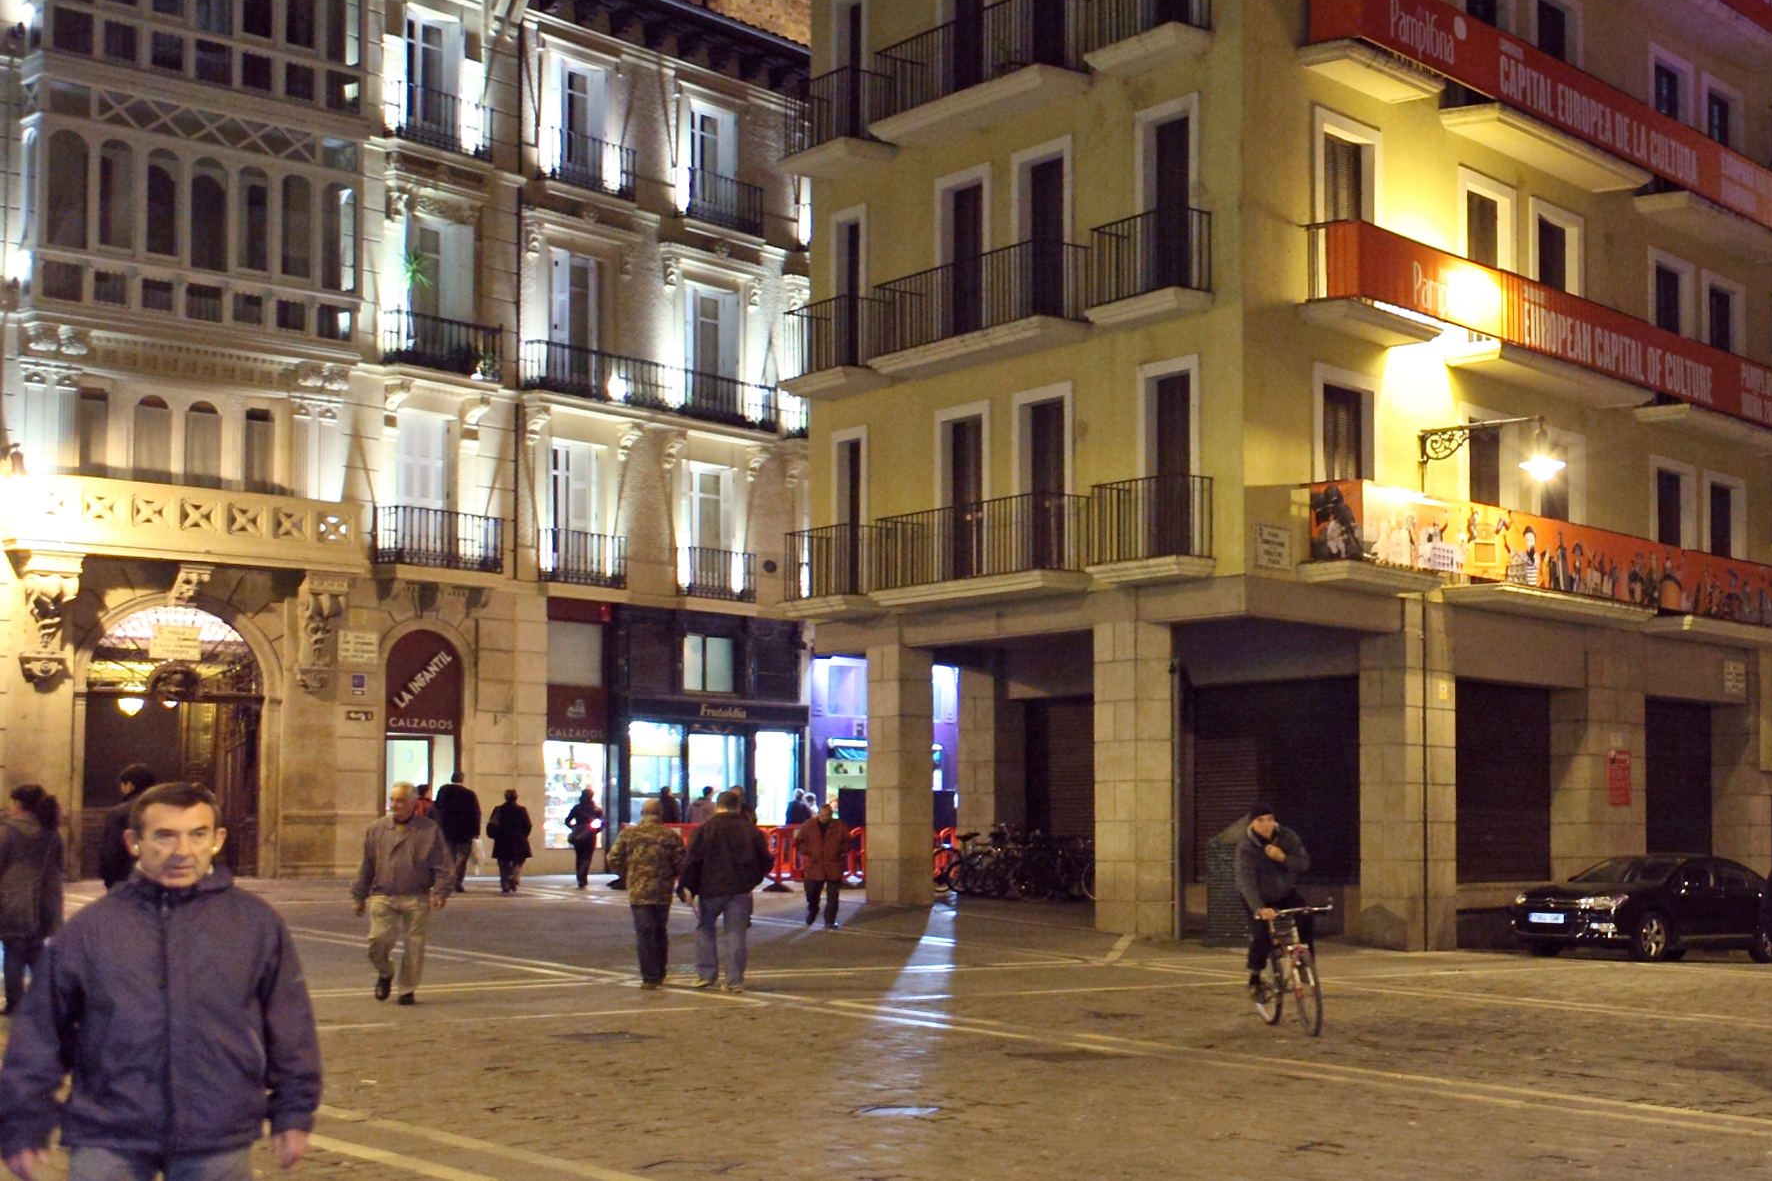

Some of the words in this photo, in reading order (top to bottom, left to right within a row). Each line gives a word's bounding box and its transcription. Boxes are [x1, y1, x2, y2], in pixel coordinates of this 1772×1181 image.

[1500, 54, 1555, 118] CAPITAL
[1557, 83, 1613, 145] EUROPEA
[1615, 111, 1631, 153] DE
[1633, 120, 1648, 161] LA
[1650, 129, 1698, 186] CULTURA
[1524, 301, 1592, 364] EUROPEAN
[1595, 327, 1645, 382] CAPITAL
[1646, 346, 1663, 387] OF
[1665, 351, 1714, 404] CULTURE
[394, 691, 414, 708] LA
[407, 650, 453, 694] INFANTIL
[389, 717, 454, 730] CALZADOS
[548, 728, 604, 739] CALZADOS
